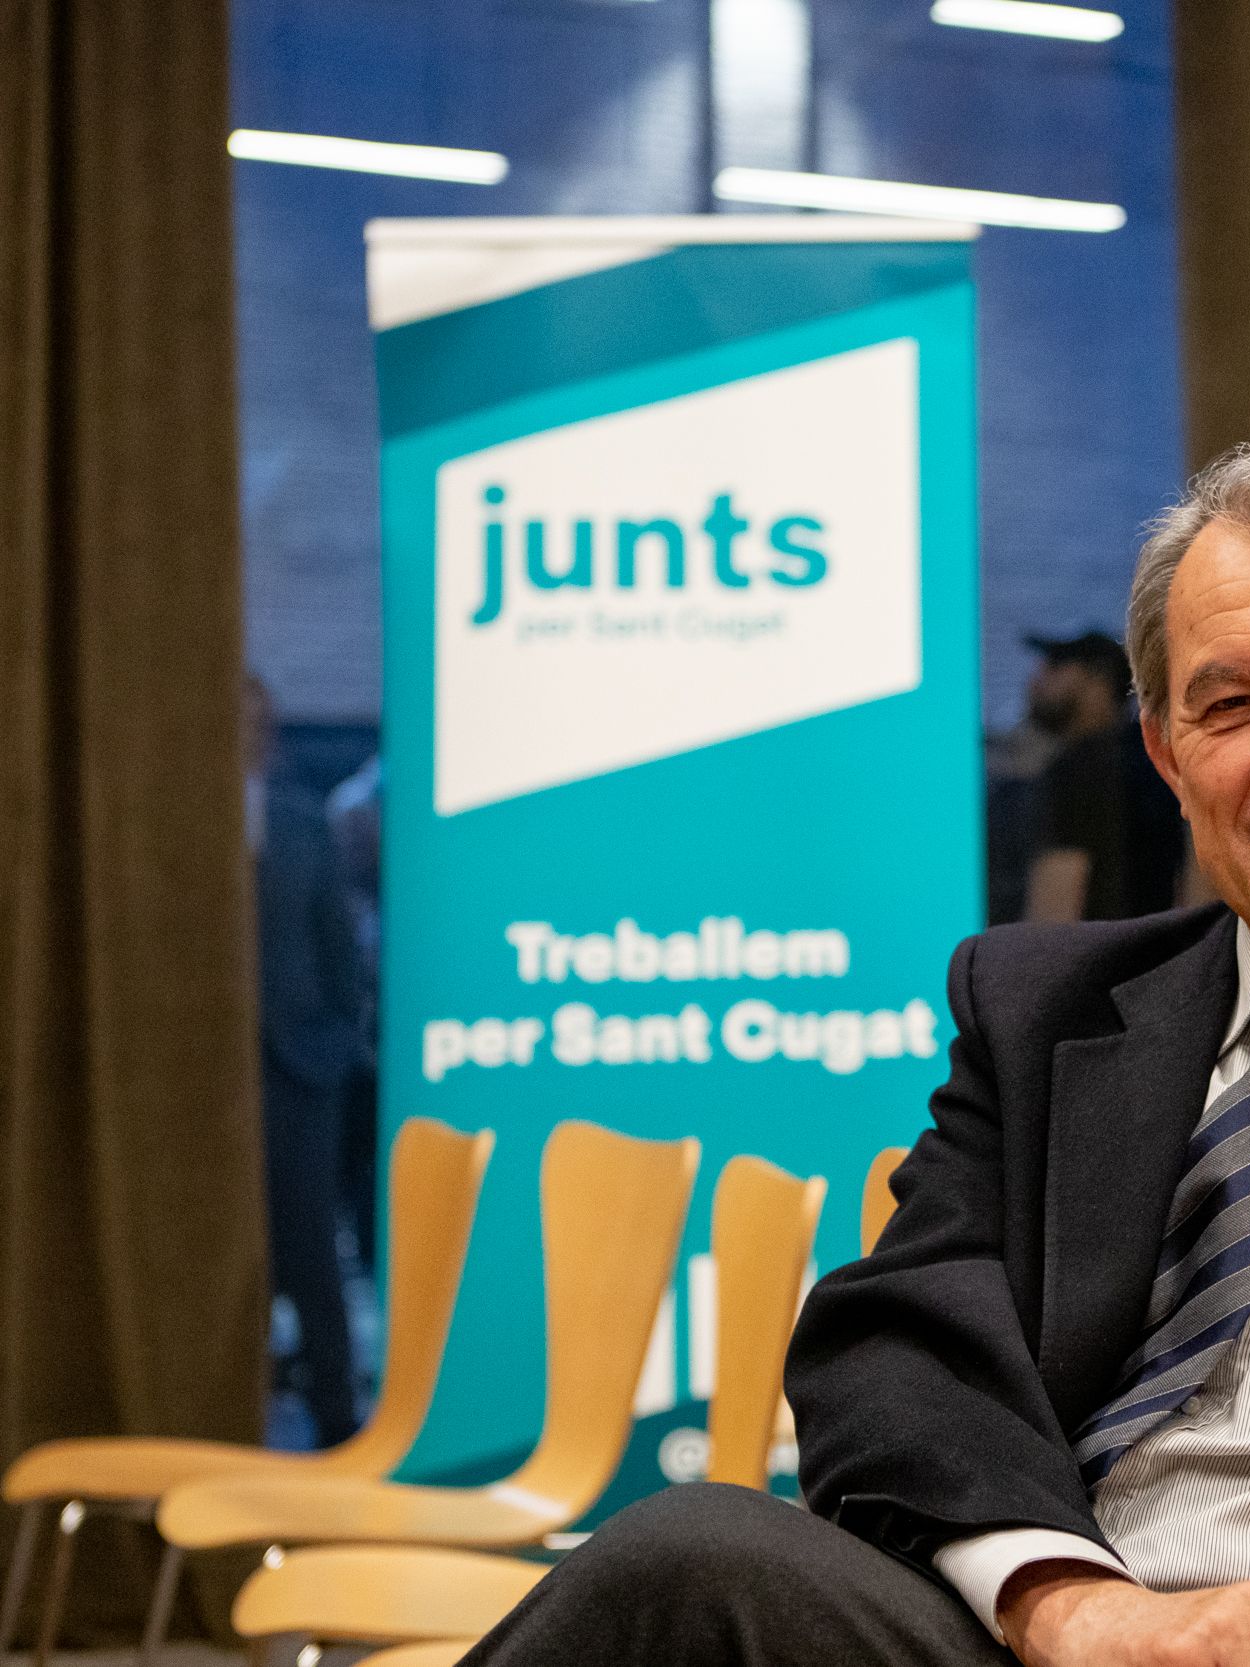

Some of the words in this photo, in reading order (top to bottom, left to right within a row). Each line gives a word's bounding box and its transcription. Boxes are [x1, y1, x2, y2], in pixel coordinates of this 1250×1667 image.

[469, 485, 830, 628] junts
[516, 612, 576, 645] per
[586, 608, 669, 640] Sant
[676, 606, 788, 645] Cugat
[506, 916, 850, 983] Treballem
[423, 1018, 545, 1082] per
[552, 1002, 712, 1066] Sant
[722, 998, 938, 1074] Cugat
